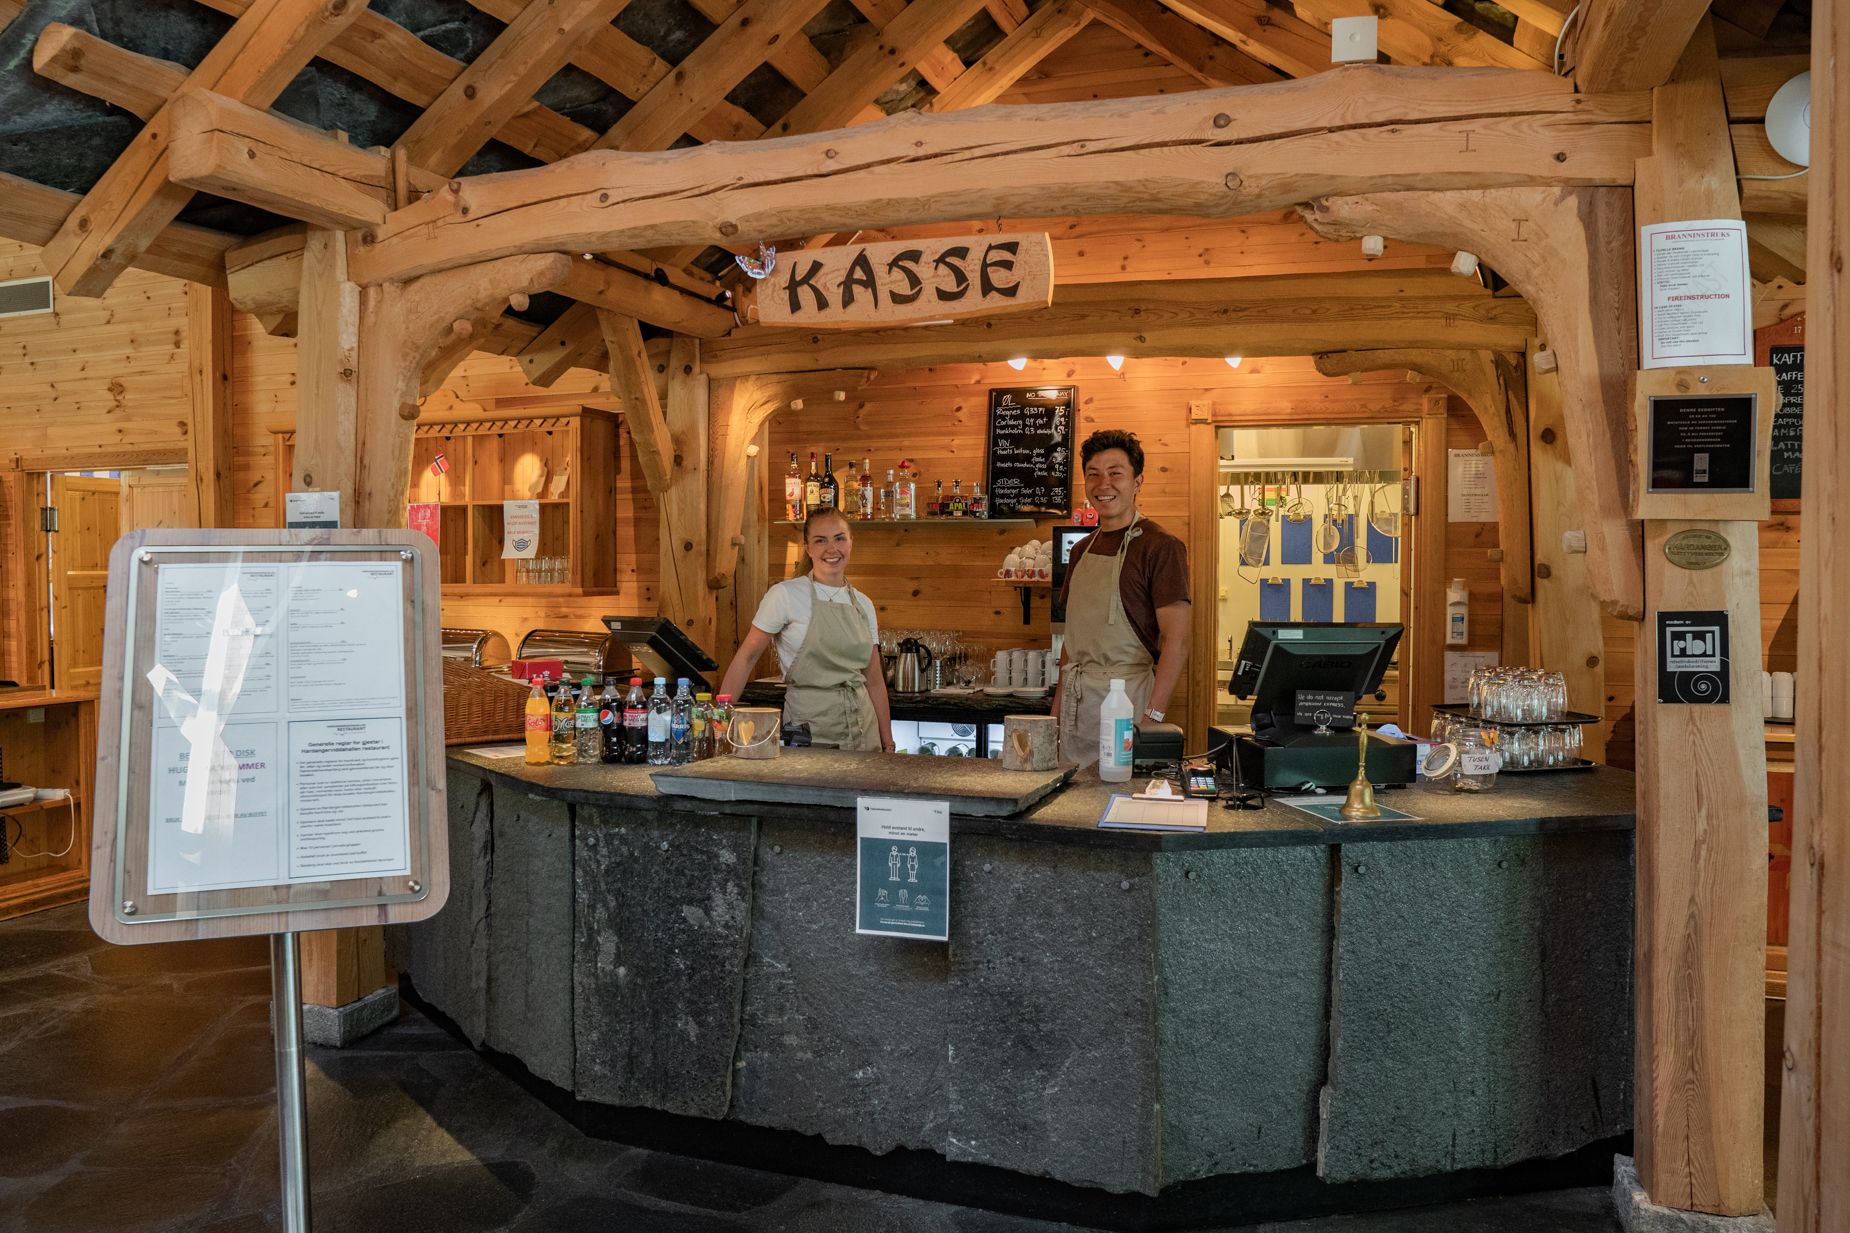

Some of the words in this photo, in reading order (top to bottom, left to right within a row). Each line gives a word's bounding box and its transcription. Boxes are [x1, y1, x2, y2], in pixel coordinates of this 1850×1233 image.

[1665, 231, 1730, 240] BRANNINSTRUKS
[782, 241, 1021, 315] KASSE
[1667, 293, 1730, 301] FIREINSTRUCTION
[1002, 394, 1016, 406] ØL
[996, 418, 1023, 428] Carlsberg
[998, 439, 1010, 447] VIN
[1673, 633, 1713, 655] rbl
[235, 749, 256, 757] DISK
